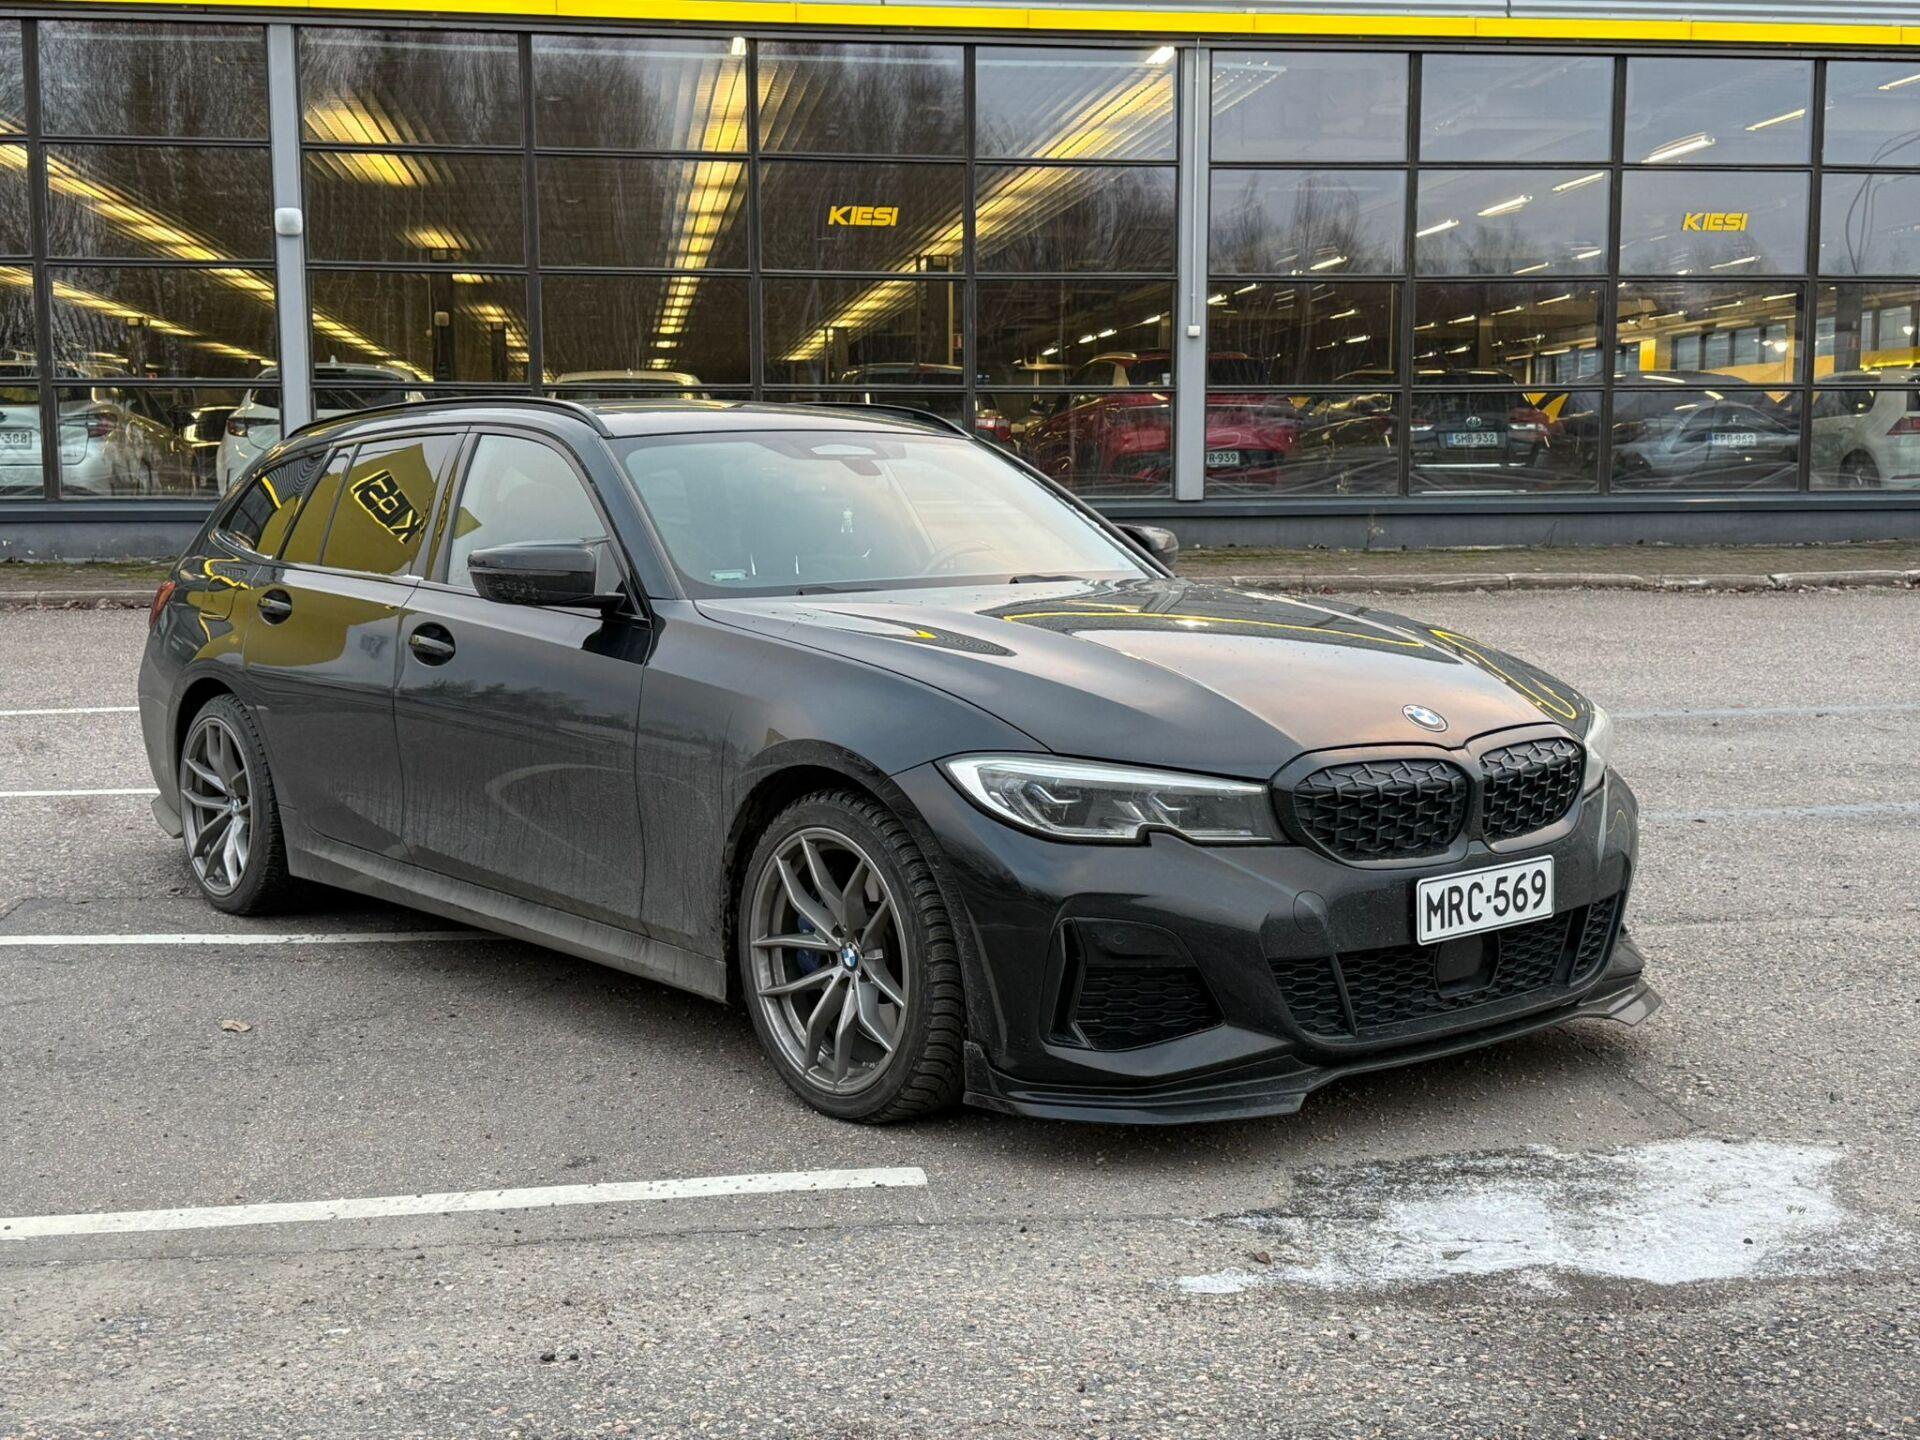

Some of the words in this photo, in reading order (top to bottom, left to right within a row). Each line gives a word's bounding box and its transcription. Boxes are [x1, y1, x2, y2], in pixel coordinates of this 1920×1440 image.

[828, 205, 899, 227] KIESI
[1682, 212, 1749, 232] KIESI
[1426, 869, 1547, 932] MRC-569
